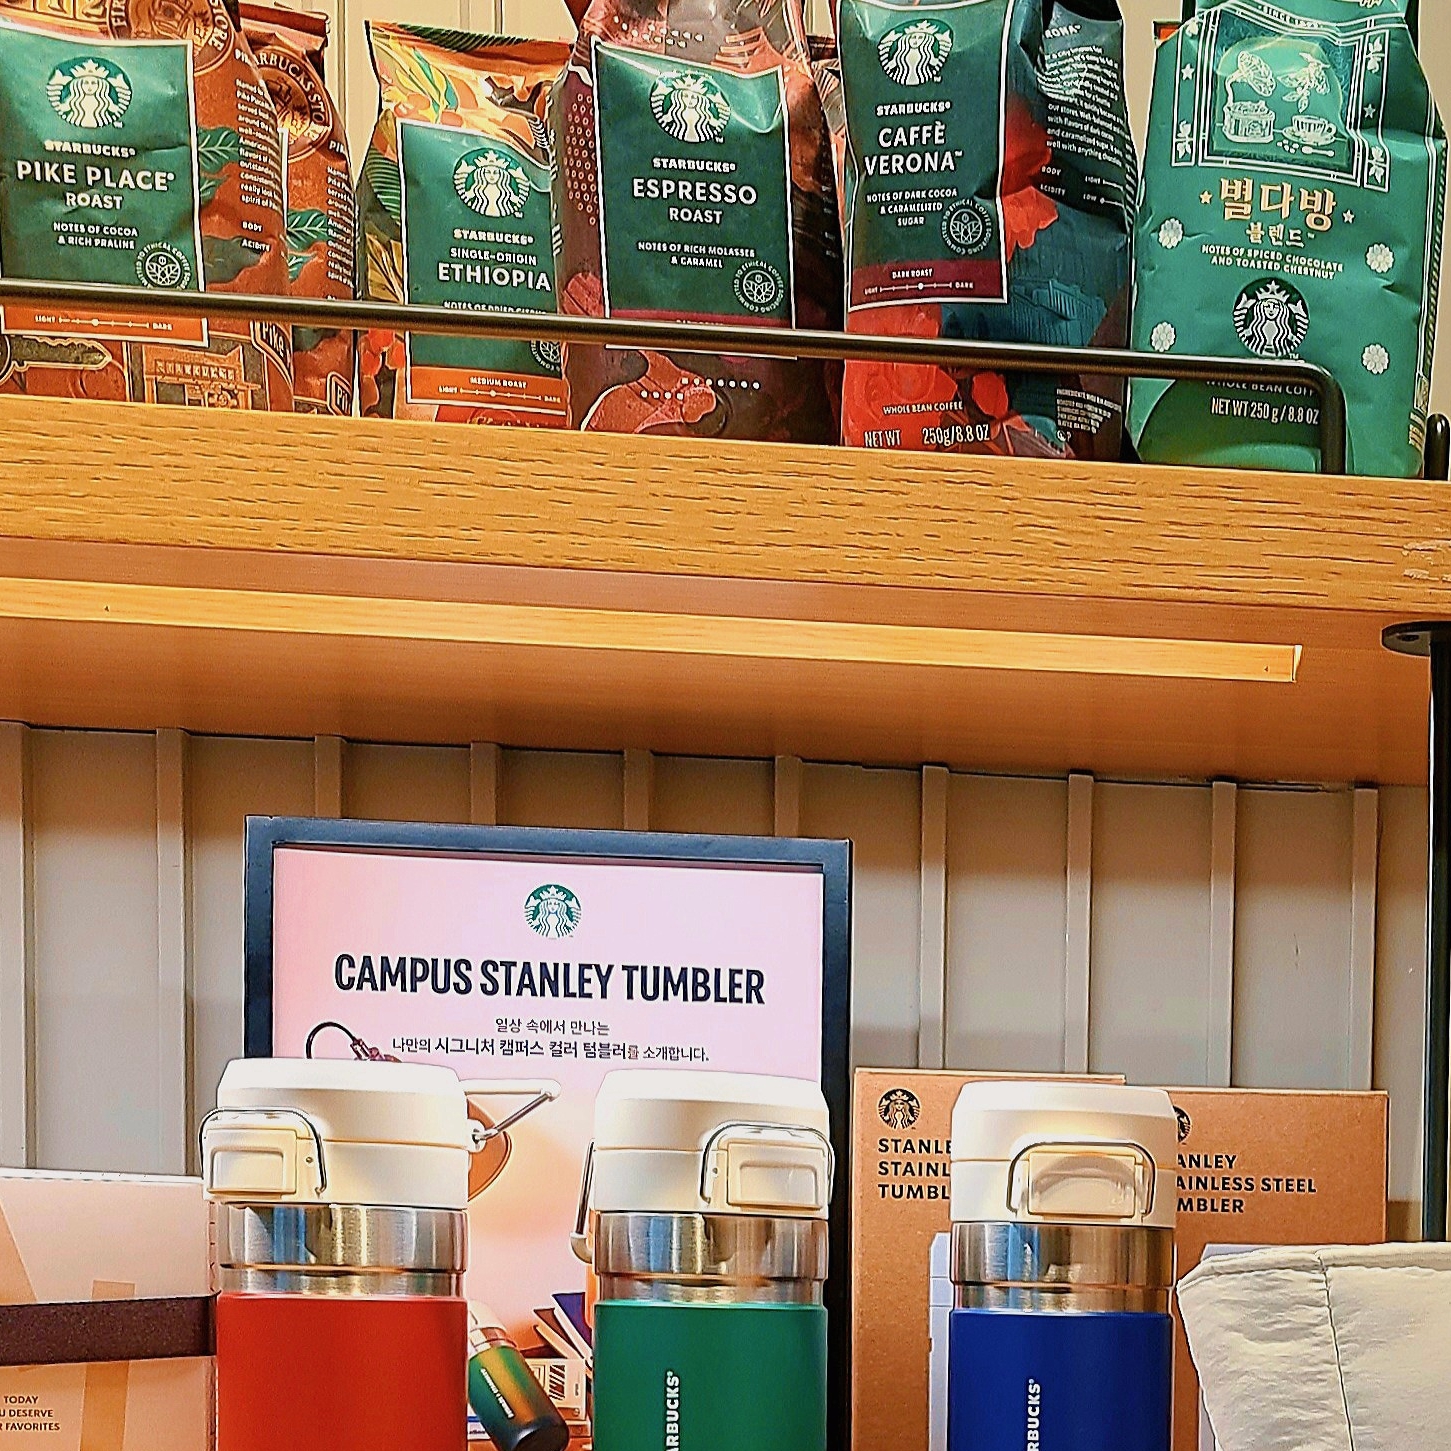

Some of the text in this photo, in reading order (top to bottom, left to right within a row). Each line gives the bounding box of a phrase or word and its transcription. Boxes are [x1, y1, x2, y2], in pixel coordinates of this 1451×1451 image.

[878, 121, 946, 148] CAFFÈ
[1047, 128, 1060, 136] and
[17, 160, 76, 183] PIKE
[1042, 166, 1061, 176] BODY
[633, 178, 757, 205] ESPRESSO
[867, 188, 958, 202] NOTES OF DARK COCOA
[1040, 184, 1066, 196] ACIDITY
[66, 192, 123, 210] ROAST
[888, 203, 943, 214] CARAMELIZED
[1220, 177, 1336, 232] 별다방
[669, 207, 723, 224] ROAST
[897, 216, 925, 227] SUGAR
[53, 222, 138, 237] NOTES OF COCOA
[68, 236, 92, 246] RICH
[94, 238, 135, 249] PRALINE
[638, 242, 755, 258] NOTES OF RICH MOLASSES
[450, 248, 537, 266] SINGLE-ORIGIN
[681, 257, 723, 268] CARAMEL
[1201, 244, 1343, 273] NOTES OF SPICED CHOCOLATE
[892, 268, 933, 279] DARK ROAST
[1211, 255, 1335, 280] AND TOASTED CHESTNUT
[438, 262, 552, 292] ETHIOPIA
[883, 401, 963, 414] WHOLE BEAN COFFEE
[1211, 397, 1231, 415] NET
[1233, 399, 1249, 417] WT
[1250, 401, 1270, 420] 250
[1271, 407, 1278, 424] g
[1288, 405, 1304, 423] 8.8
[1306, 408, 1320, 425] OZ
[864, 430, 884, 447] NET
[885, 430, 901, 445] WT
[976, 424, 990, 442] OZ
[334, 953, 766, 1005] CAMPUS STANLEY TUMBLER
[496, 1018, 609, 1036] 일상 속에서 만나는
[392, 1037, 431, 1053] 나만의
[435, 1038, 495, 1056] 시그니처
[499, 1040, 544, 1057] 캠퍼스
[549, 1040, 578, 1058] 컬러
[643, 1046, 710, 1062] 소개합니다.
[878, 1161, 950, 1177] STAINL
[1177, 1153, 1237, 1169] ANLEY
[878, 1184, 950, 1199] TUMBL
[1176, 1176, 1316, 1193] AINLESS STEEL
[1177, 1198, 1244, 1213] MBLER
[4, 1395, 39, 1404] TODAY
[9, 1409, 54, 1417] DESERVE
[5, 1422, 60, 1431] FAVORITES
